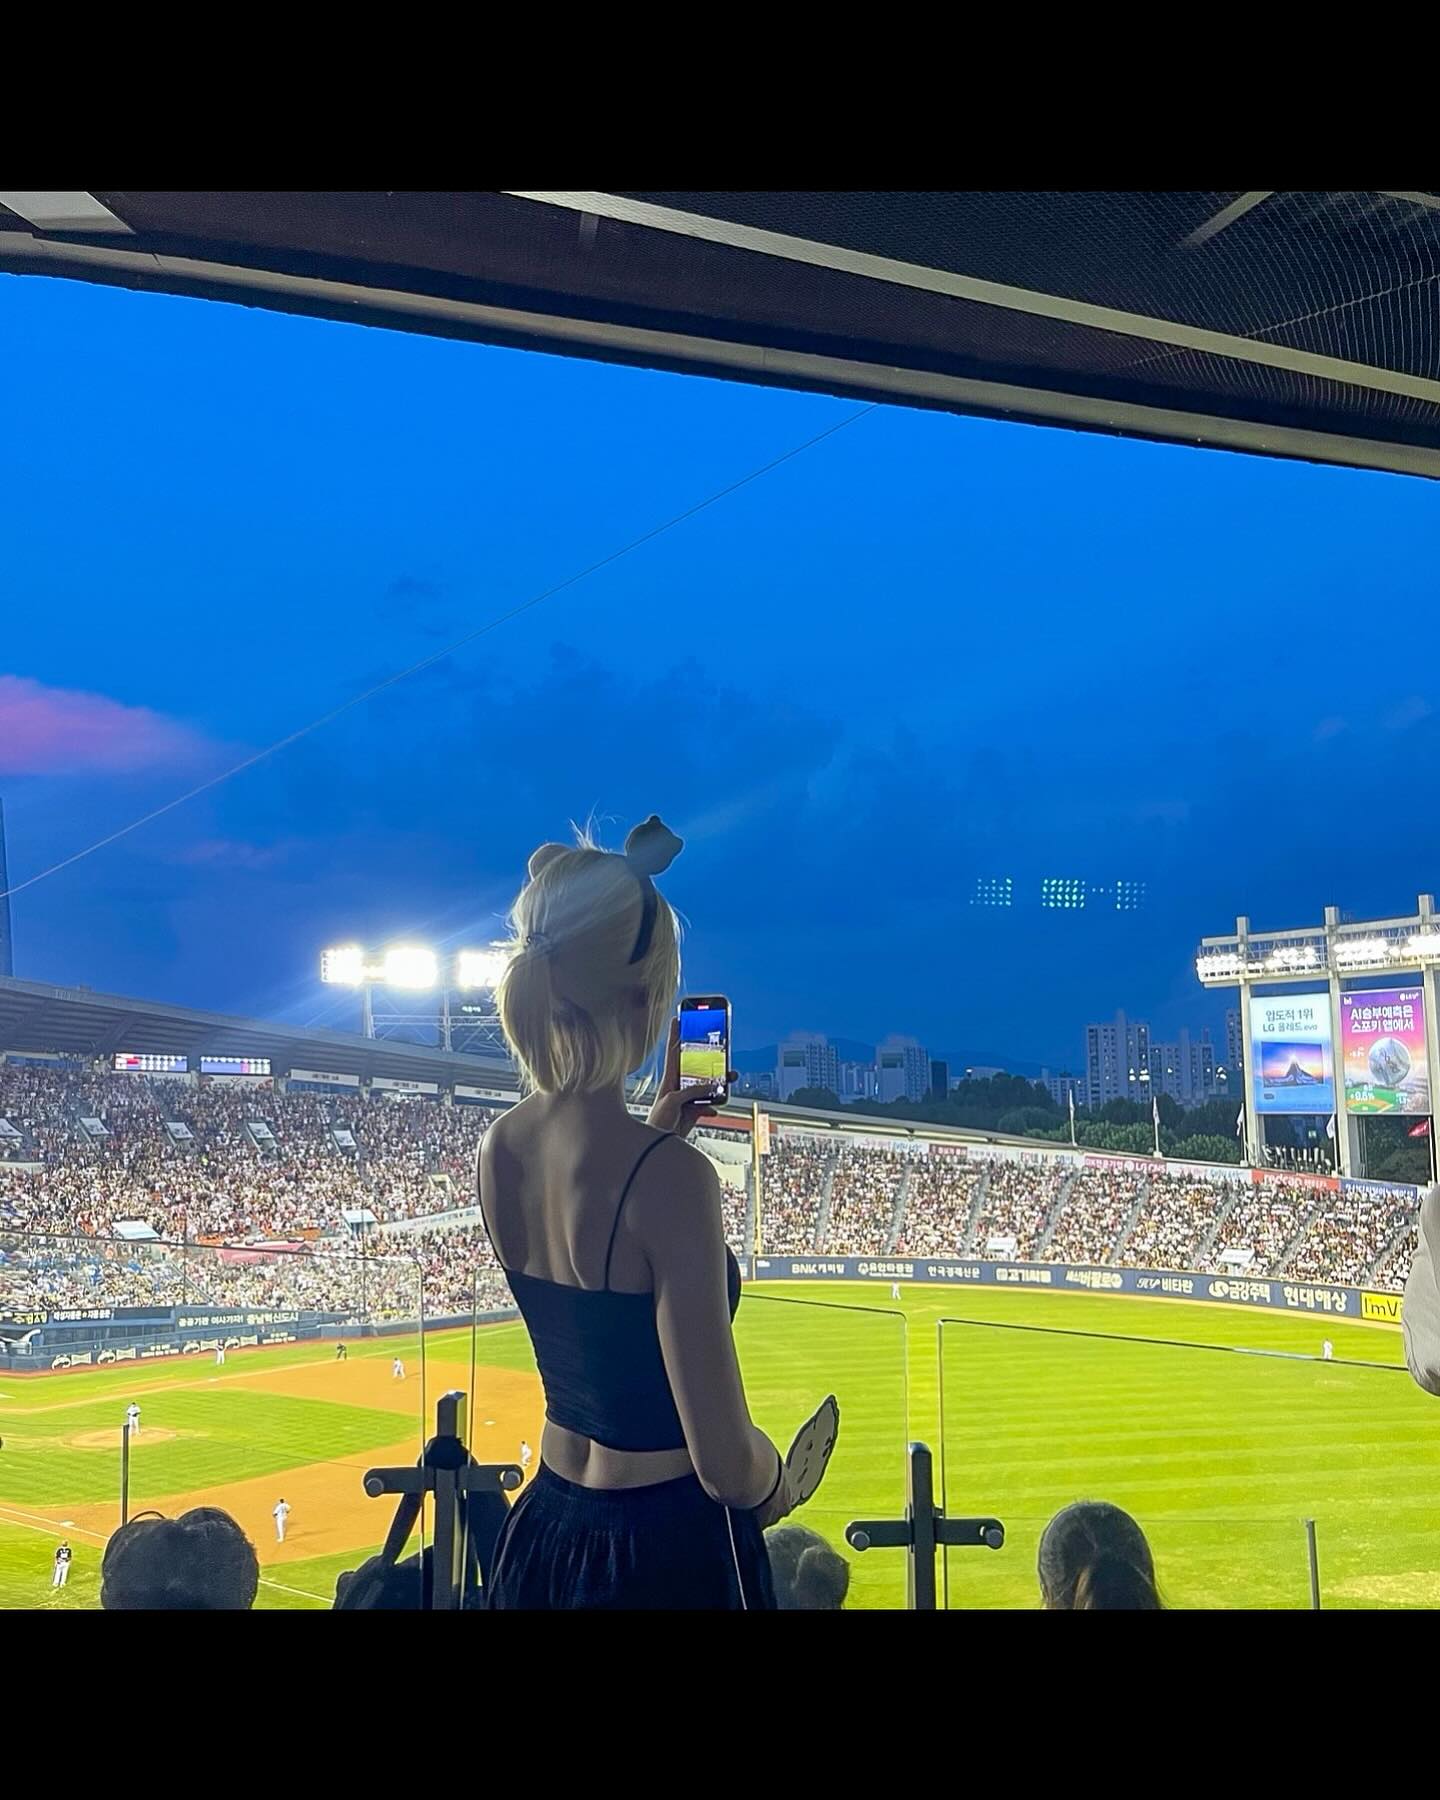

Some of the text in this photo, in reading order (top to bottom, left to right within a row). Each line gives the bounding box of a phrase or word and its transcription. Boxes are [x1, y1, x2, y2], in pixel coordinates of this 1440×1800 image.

[1265, 1008, 1314, 1022] 압도적 1위
[1262, 1023, 1275, 1032] LG
[1382, 1019, 1414, 1032] 앱에서
[1228, 1280, 1271, 1303] 금강주택
[1283, 1286, 1348, 1312] 현대해상
